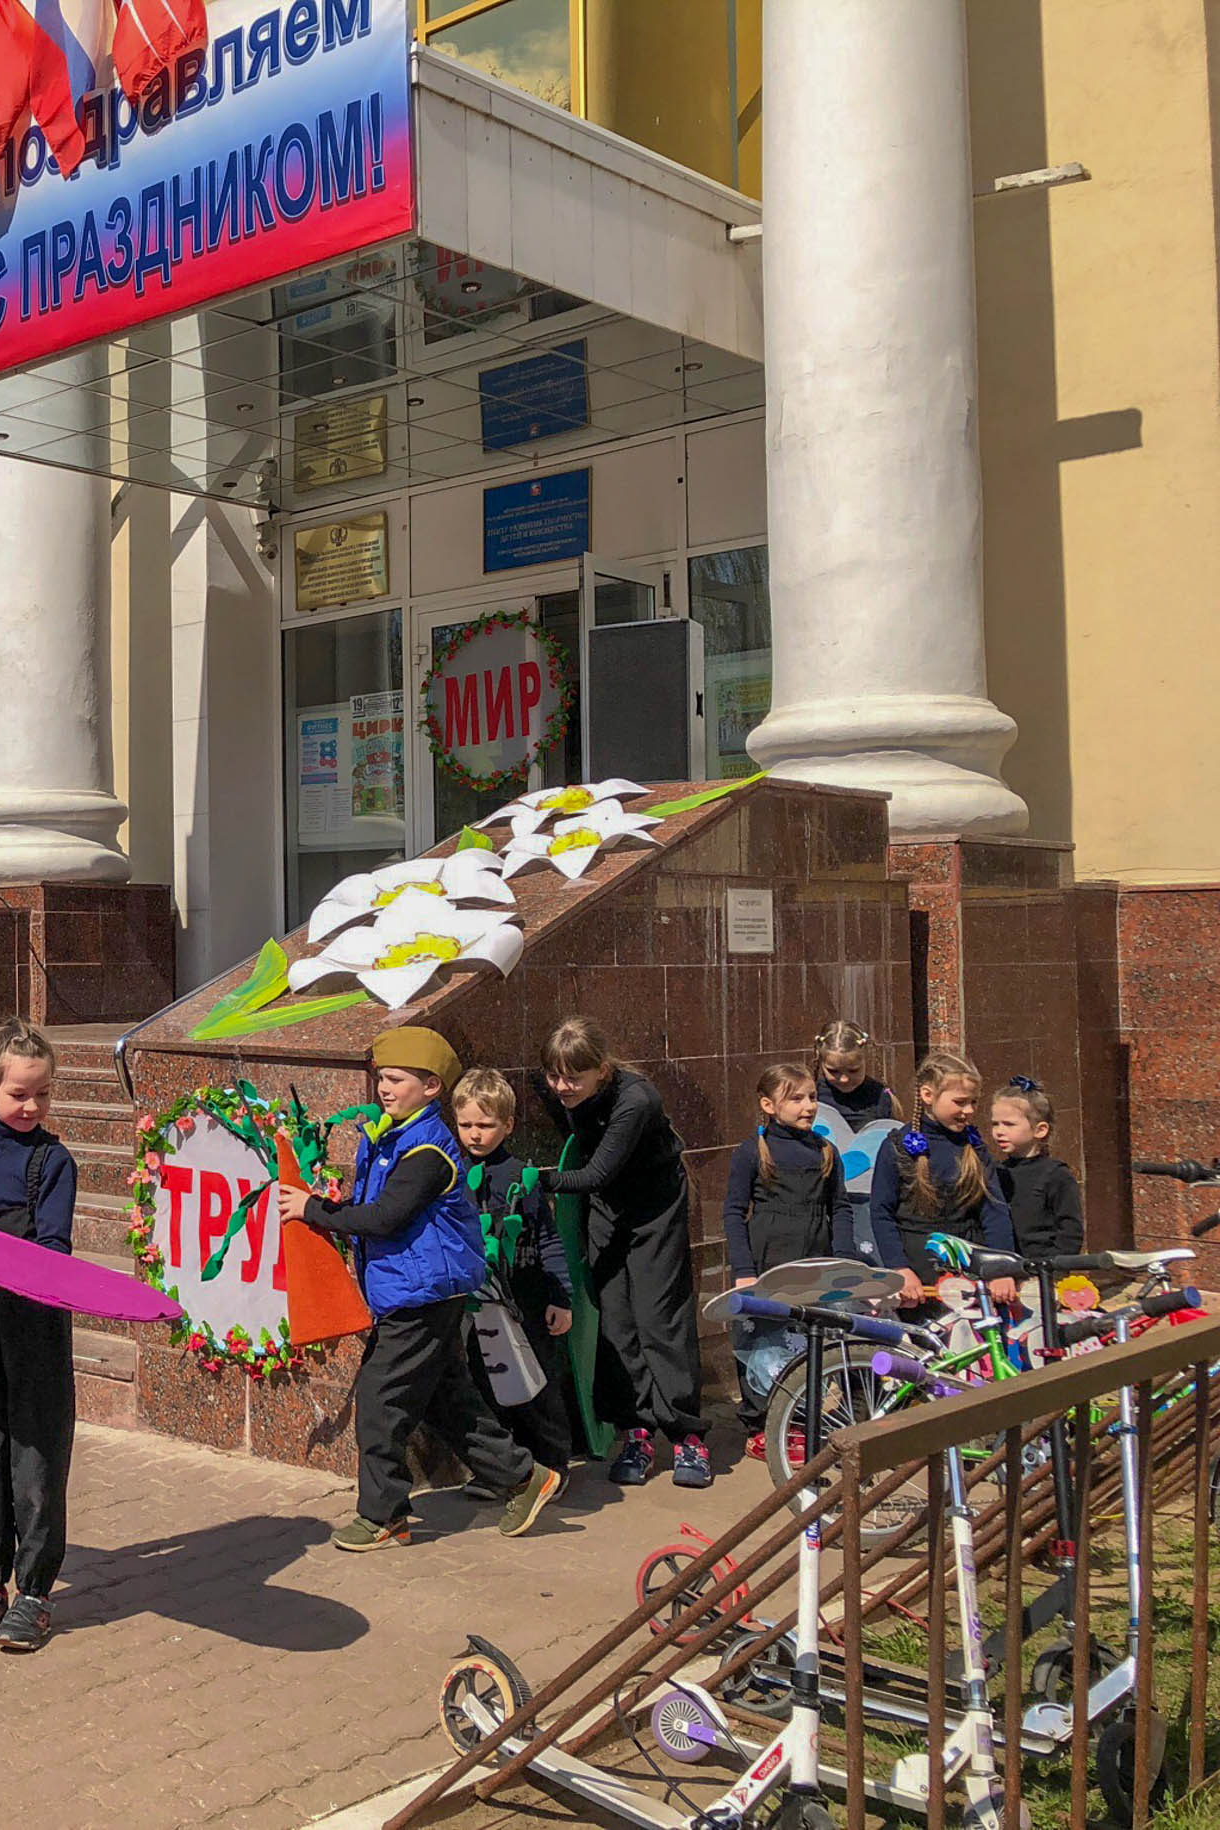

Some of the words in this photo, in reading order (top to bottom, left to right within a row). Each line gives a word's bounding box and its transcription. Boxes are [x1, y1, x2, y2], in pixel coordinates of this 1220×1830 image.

[20, 92, 387, 322] ПРАЗДНИКОМ!
[352, 697, 363, 711] 19
[445, 661, 541, 748] МИР
